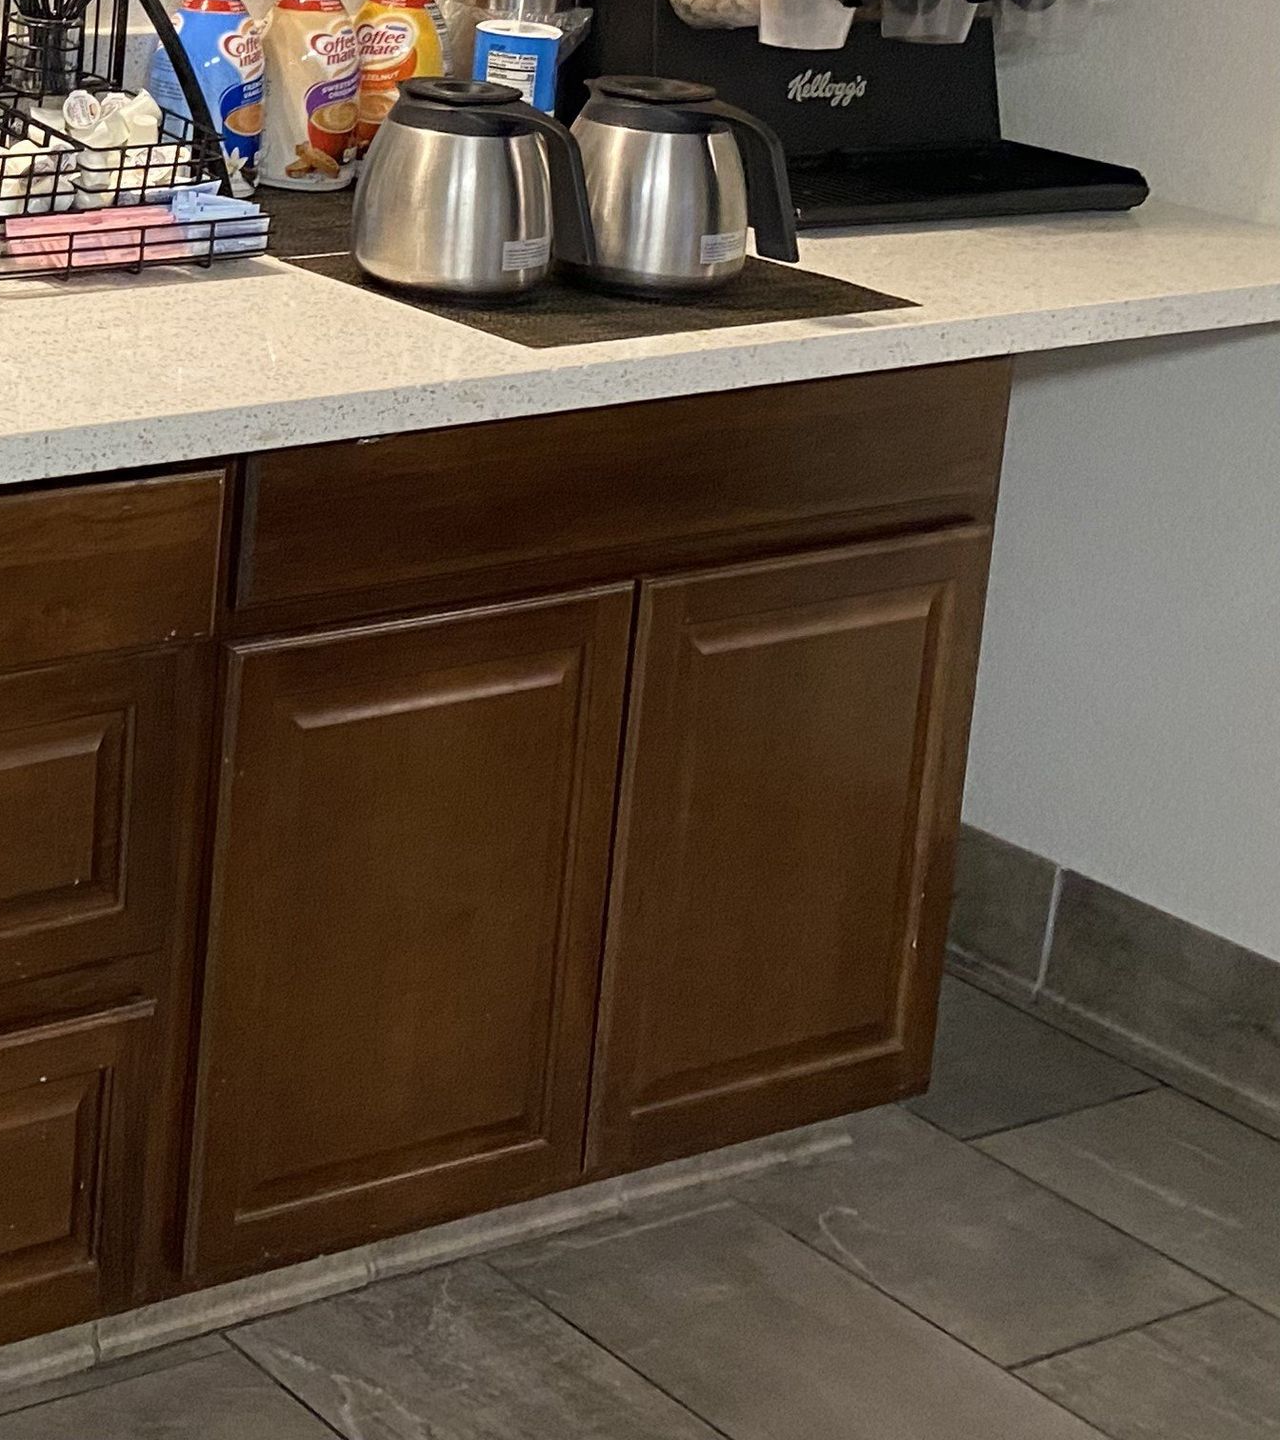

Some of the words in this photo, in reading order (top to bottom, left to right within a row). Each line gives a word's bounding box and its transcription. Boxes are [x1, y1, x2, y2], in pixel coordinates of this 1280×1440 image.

[356, 23, 406, 45] Coffee
[359, 43, 400, 56] mate
[787, 69, 867, 107] Kellogg's
